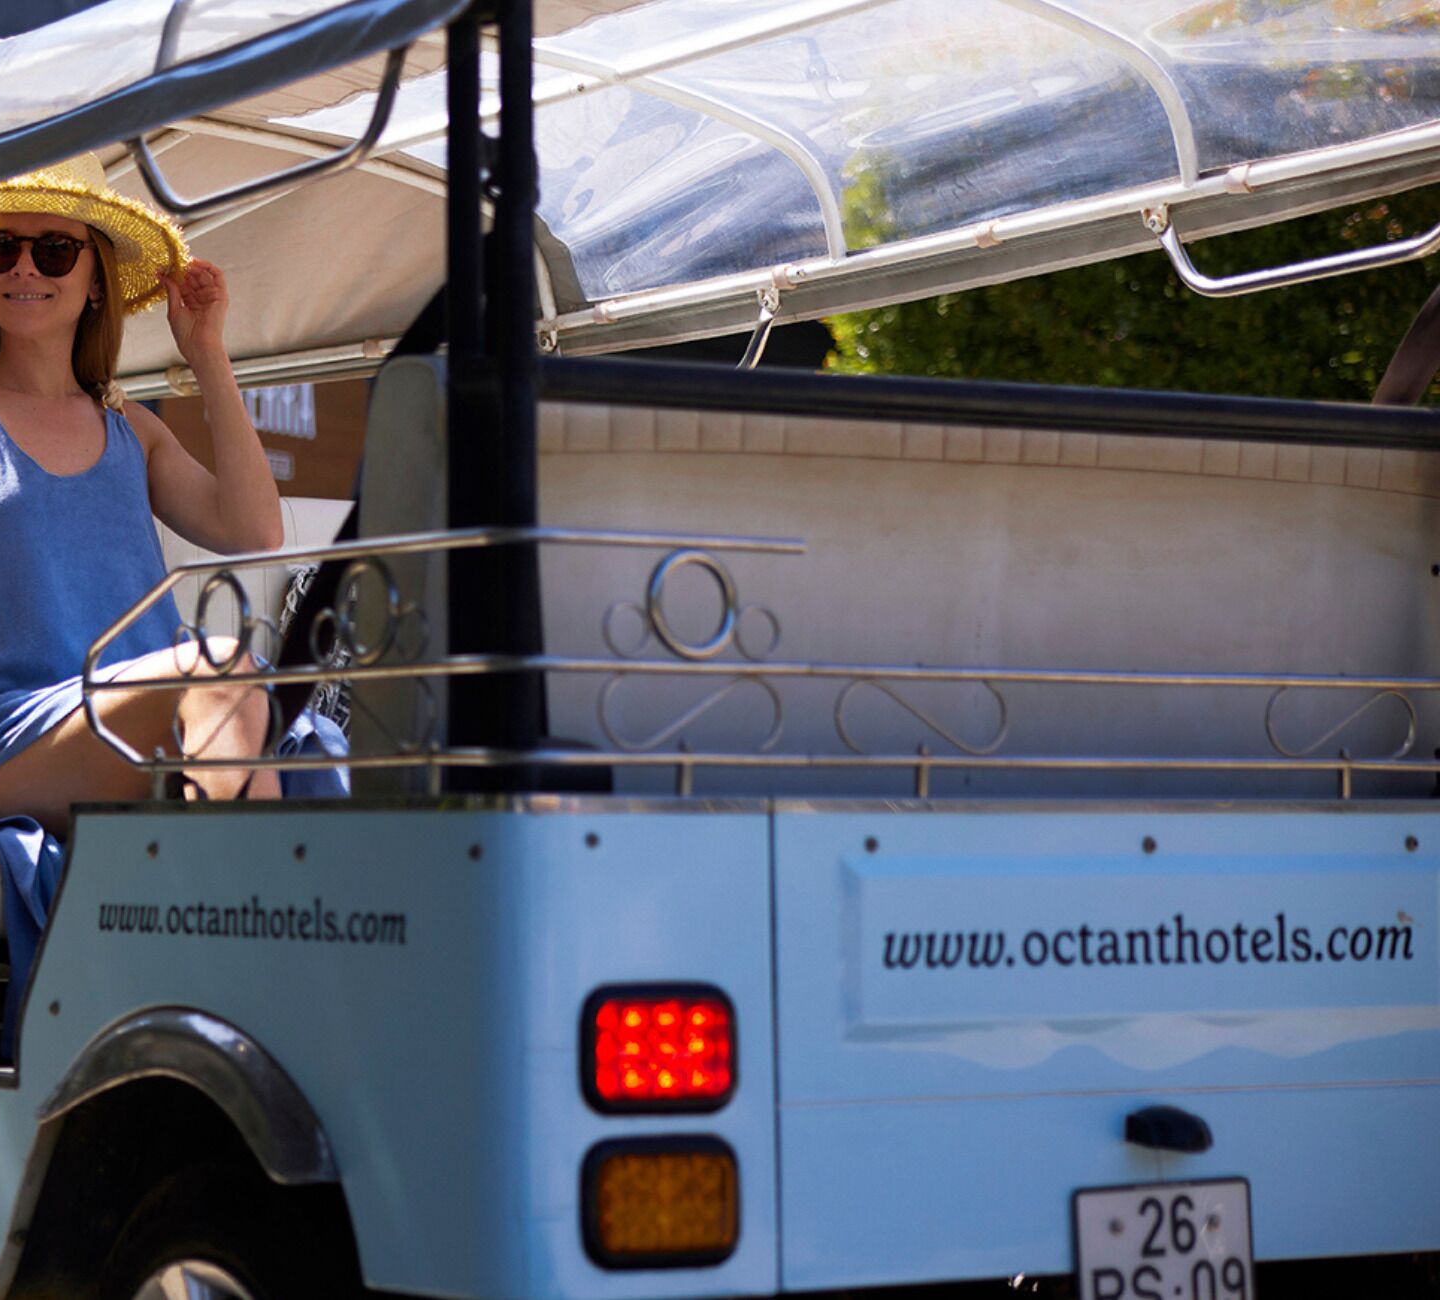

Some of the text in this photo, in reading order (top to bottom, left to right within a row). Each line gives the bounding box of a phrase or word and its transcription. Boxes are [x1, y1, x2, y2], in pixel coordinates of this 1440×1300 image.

[98, 896, 407, 945] www.octanthotels.com
[882, 912, 1415, 969] www.octanthotels.com
[1138, 1194, 1197, 1258] 26
